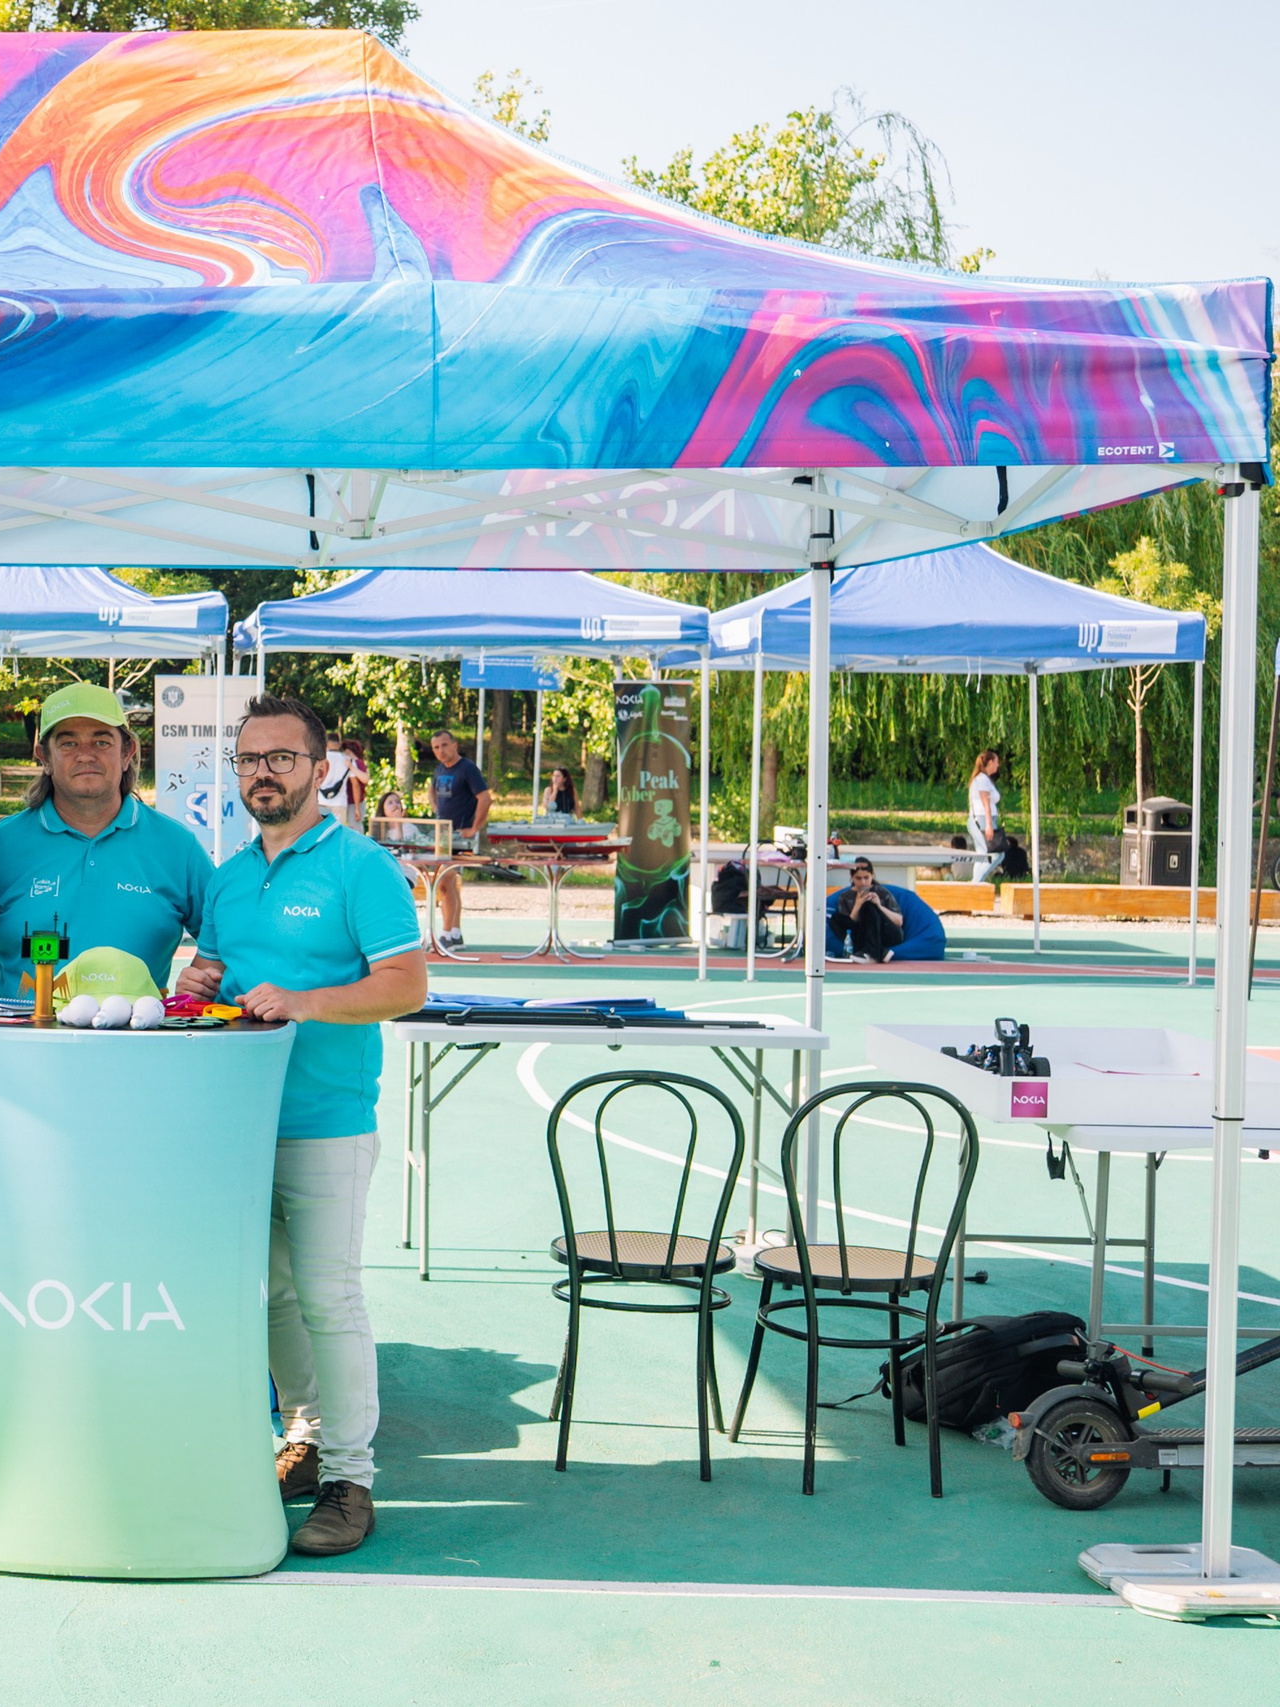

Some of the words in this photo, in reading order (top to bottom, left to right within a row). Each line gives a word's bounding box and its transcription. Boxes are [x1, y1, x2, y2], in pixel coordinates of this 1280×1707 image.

[1097, 445, 1154, 456] ECOTENT
[616, 694, 644, 705] NOKIA
[161, 724, 188, 738] CSM
[640, 769, 679, 789] Peak
[117, 882, 151, 894] NOKIA
[283, 905, 321, 918] NOKIA
[81, 972, 115, 982] NOKIA
[1013, 1095, 1046, 1105] NOKIA
